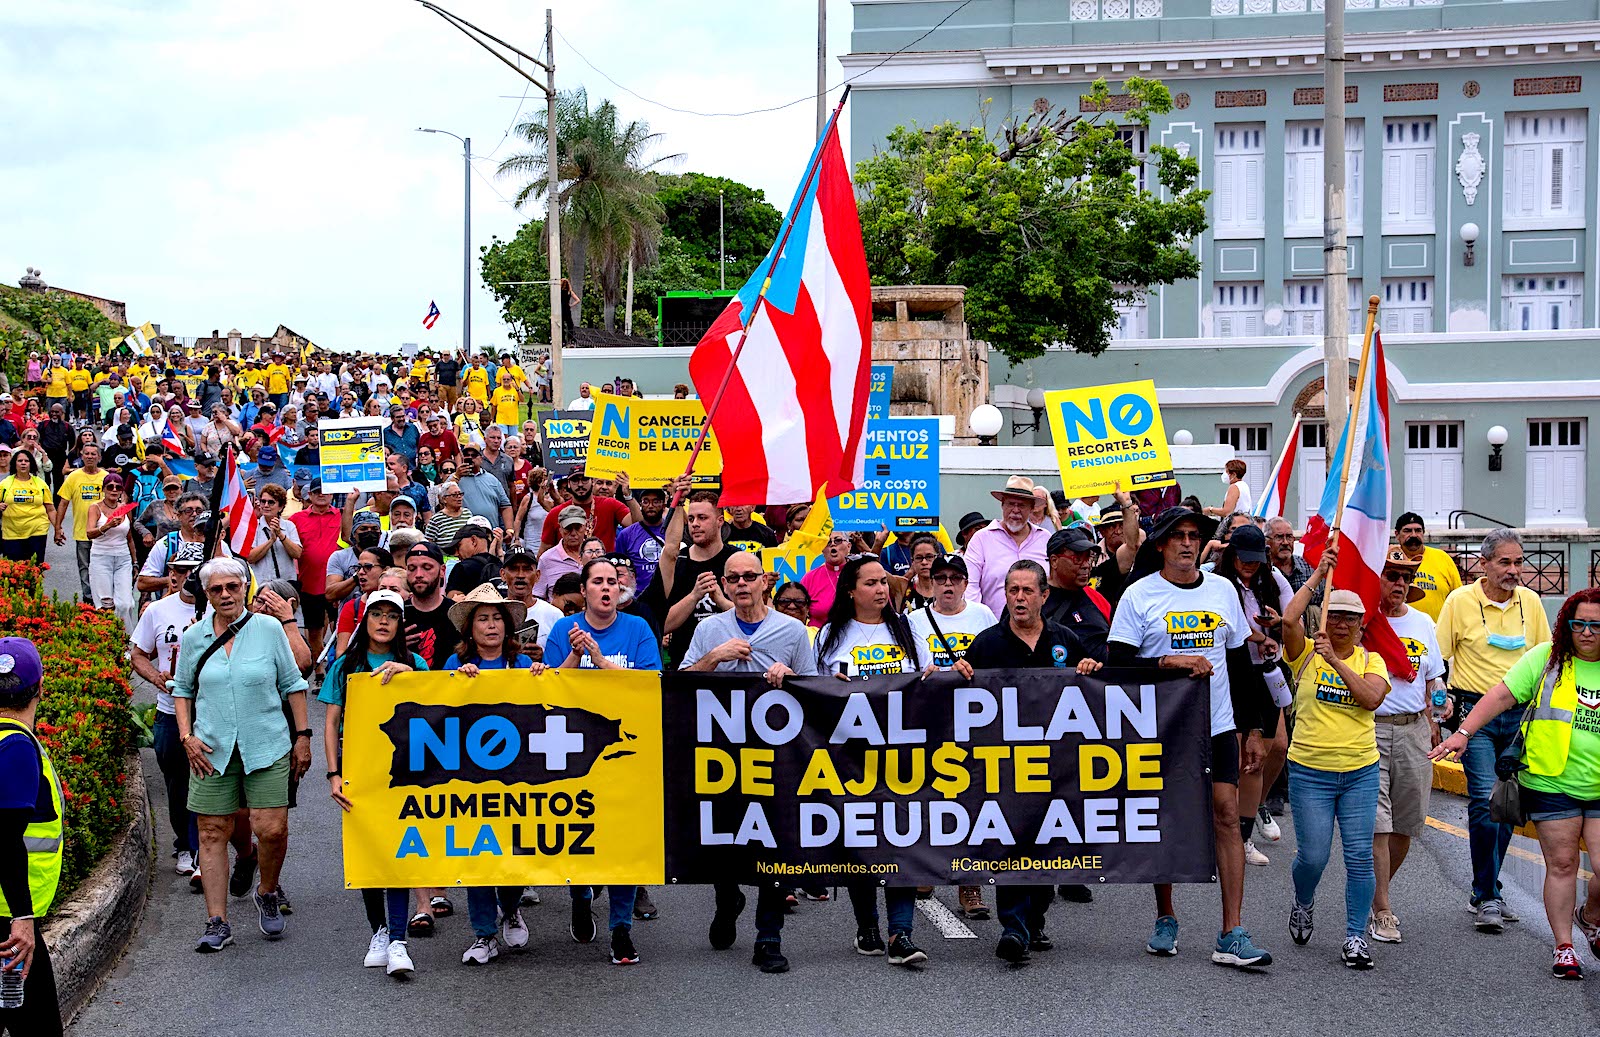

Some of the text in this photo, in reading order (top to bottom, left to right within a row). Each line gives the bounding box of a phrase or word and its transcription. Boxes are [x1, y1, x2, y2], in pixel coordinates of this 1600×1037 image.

[638, 428, 657, 438] LA
[639, 442, 711, 451] DE LA AE
[1143, 437, 1153, 447] A
[549, 449, 558, 458] A
[561, 449, 575, 457] LA
[890, 444, 928, 459] LUZ
[1071, 450, 1157, 468] PENSIONADOS
[839, 492, 928, 509] DE VIDA
[1172, 638, 1213, 648] A LA LUZ
[1327, 694, 1340, 703] LA
[695, 684, 1158, 745] NO AL PLAN
[1575, 722, 1589, 732] PARA
[695, 747, 775, 796] DE
[1079, 743, 1164, 792] DE
[700, 797, 1161, 848] LA DEUDA AEE
[395, 823, 595, 858] A LA LUZ
[757, 855, 1103, 875] NoMasAumentos.com #CancelaDeudaAEE
